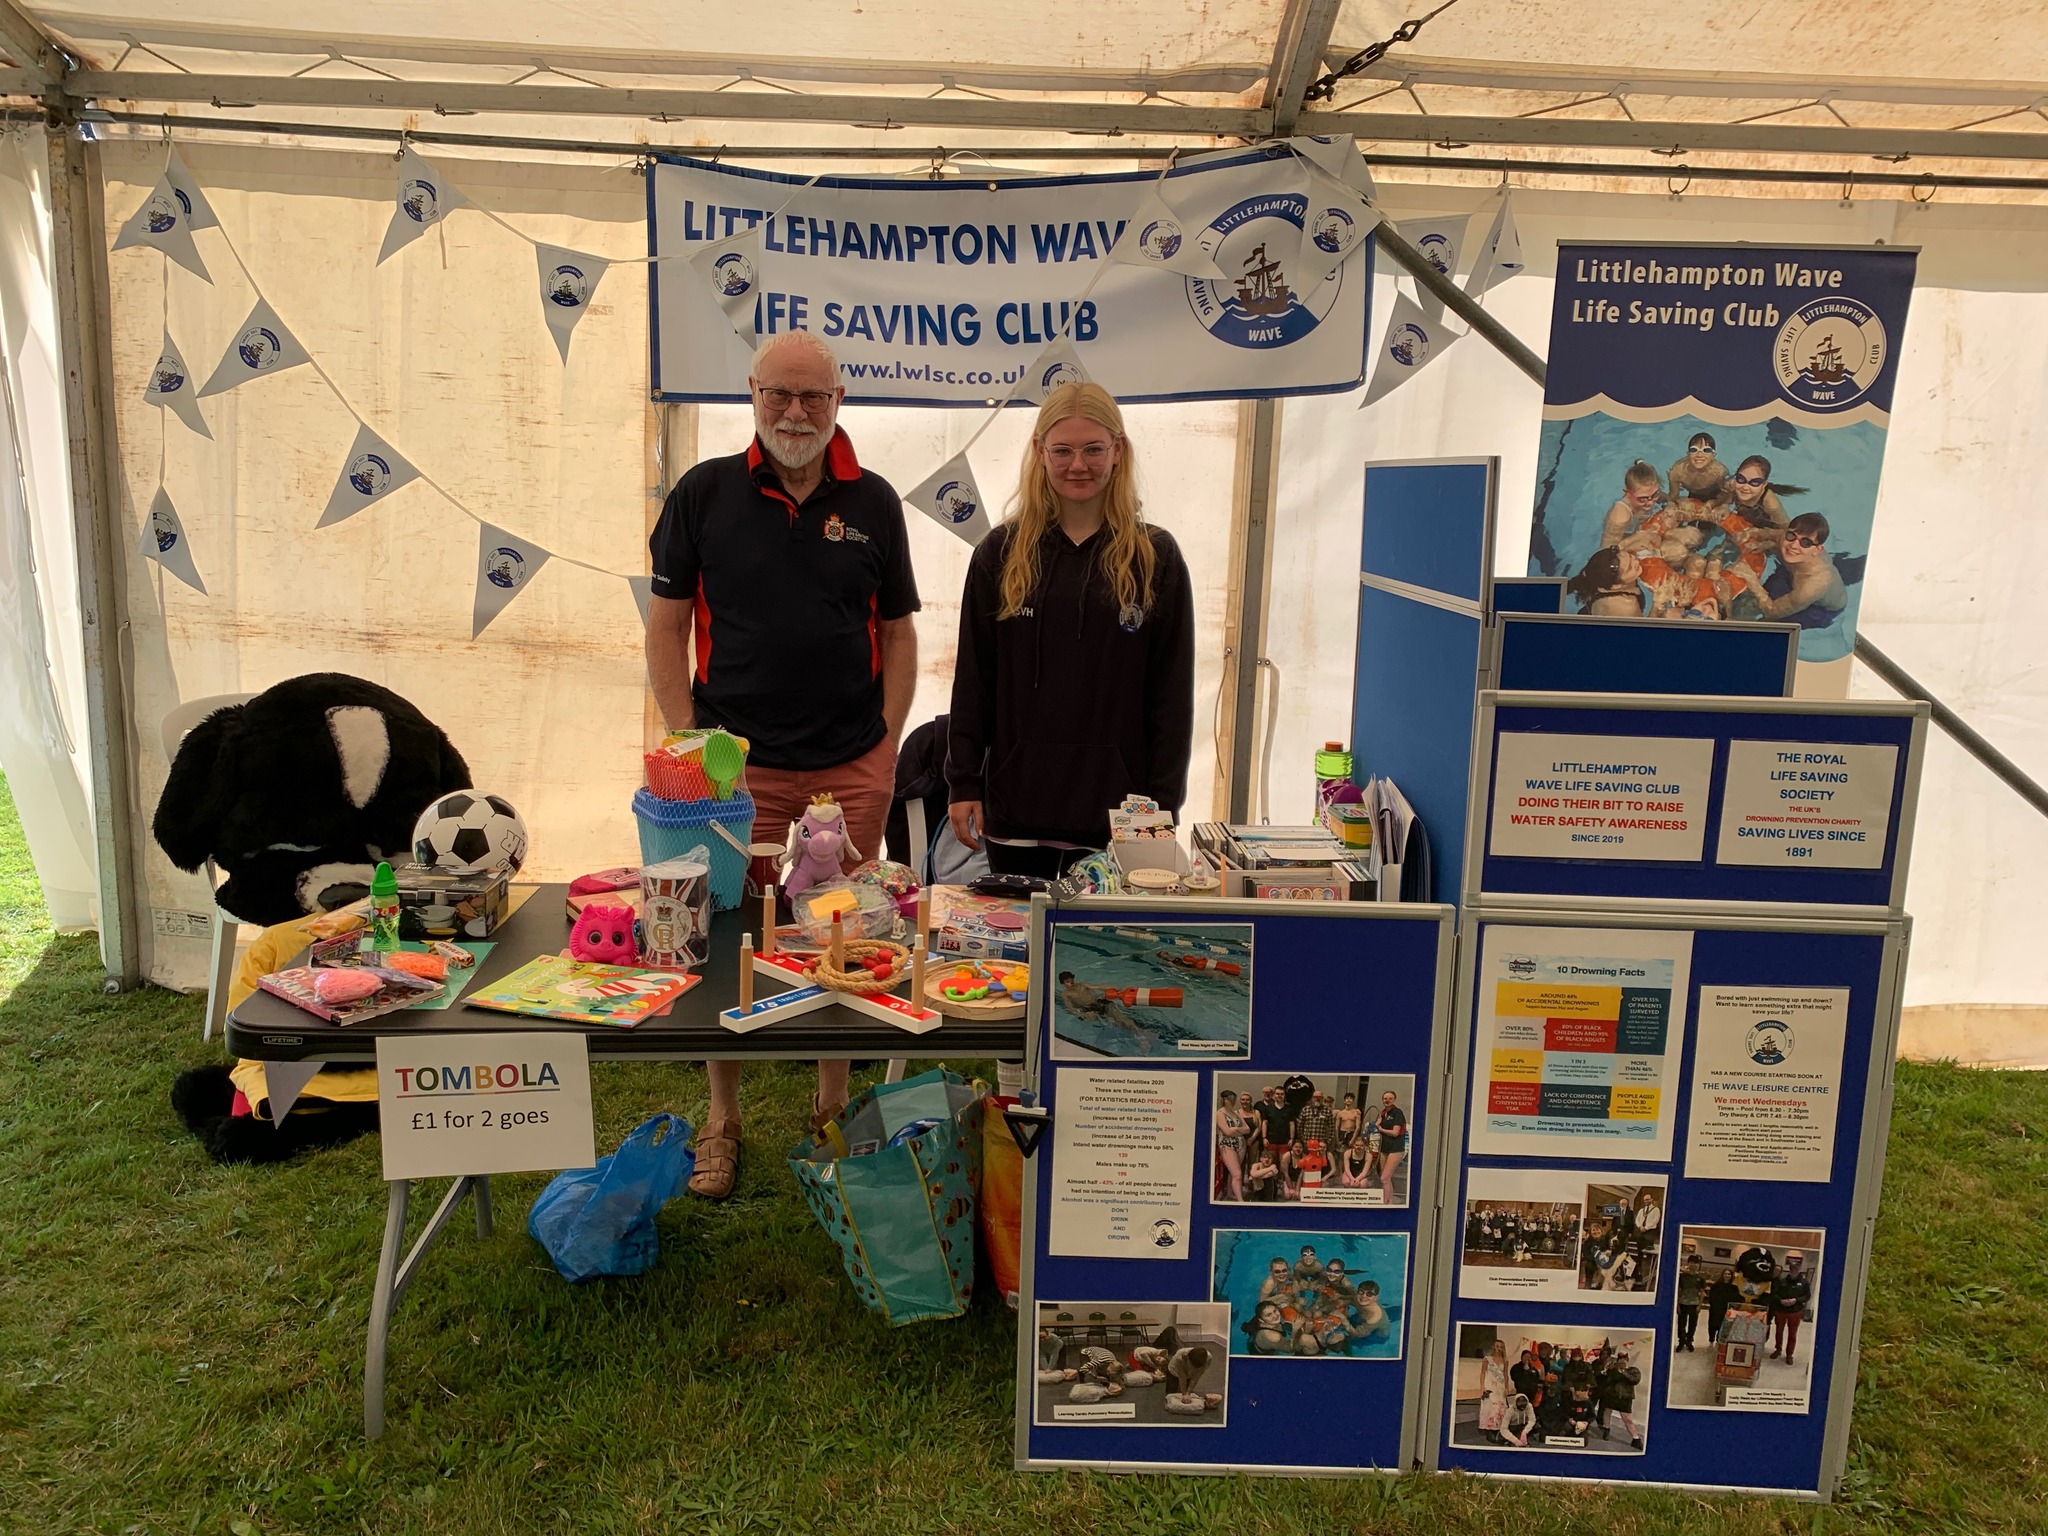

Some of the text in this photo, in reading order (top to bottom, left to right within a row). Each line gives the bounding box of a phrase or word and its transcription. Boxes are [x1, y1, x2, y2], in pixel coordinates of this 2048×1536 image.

[1217, 200, 1307, 232] LITTLEHAMPTO
[684, 200, 1017, 264] LITTLEHAMPTON
[1030, 219, 1131, 264] WAV
[1576, 259, 1843, 290] Littlehampton Wave
[1192, 276, 1214, 316] AVING
[735, 292, 1098, 346] IFE SAVING CLUB
[1572, 300, 1780, 331] Life Saving Club
[1802, 304, 1868, 324] LITTLEHAMPTON
[1248, 326, 1283, 342] WAVE
[1781, 326, 1797, 378] LIFE SAVING
[1870, 344, 1880, 365] CLUB
[840, 361, 1025, 385] ww.lwlsc.co.u
[1812, 390, 1836, 400] WAVE
[1777, 752, 1847, 764] THE ROYAL
[1552, 762, 1657, 775] LITTLEHAMPTON
[1770, 771, 1848, 783] LIFE SAVING
[1526, 780, 1680, 794] WAVE LIFE SAVING CLUB
[1780, 789, 1835, 800] SOCIETY
[1518, 797, 1684, 812] DOING THEIR BIT TO RAISE
[1511, 814, 1688, 830] WATER SAFETY AWARENESS
[1746, 815, 1784, 823] DROWNING
[1831, 818, 1861, 826] CHARITY
[1571, 834, 1624, 844] SINCE 2019
[1738, 827, 1866, 841] SAVING LIVES SINCE
[1785, 847, 1813, 857] 1891
[1557, 966, 1646, 977] 10 Drowning Facts
[395, 1062, 559, 1092] TOMBOLA
[1722, 1083, 1749, 1091] WAVE
[1751, 1084, 1790, 1092] LEISURE
[1792, 1086, 1829, 1094] CENTRE
[1752, 1098, 1807, 1107] Wednesdays
[412, 1110, 549, 1130] £1 for 2 goes
[1538, 1120, 1564, 1128] Drowning
